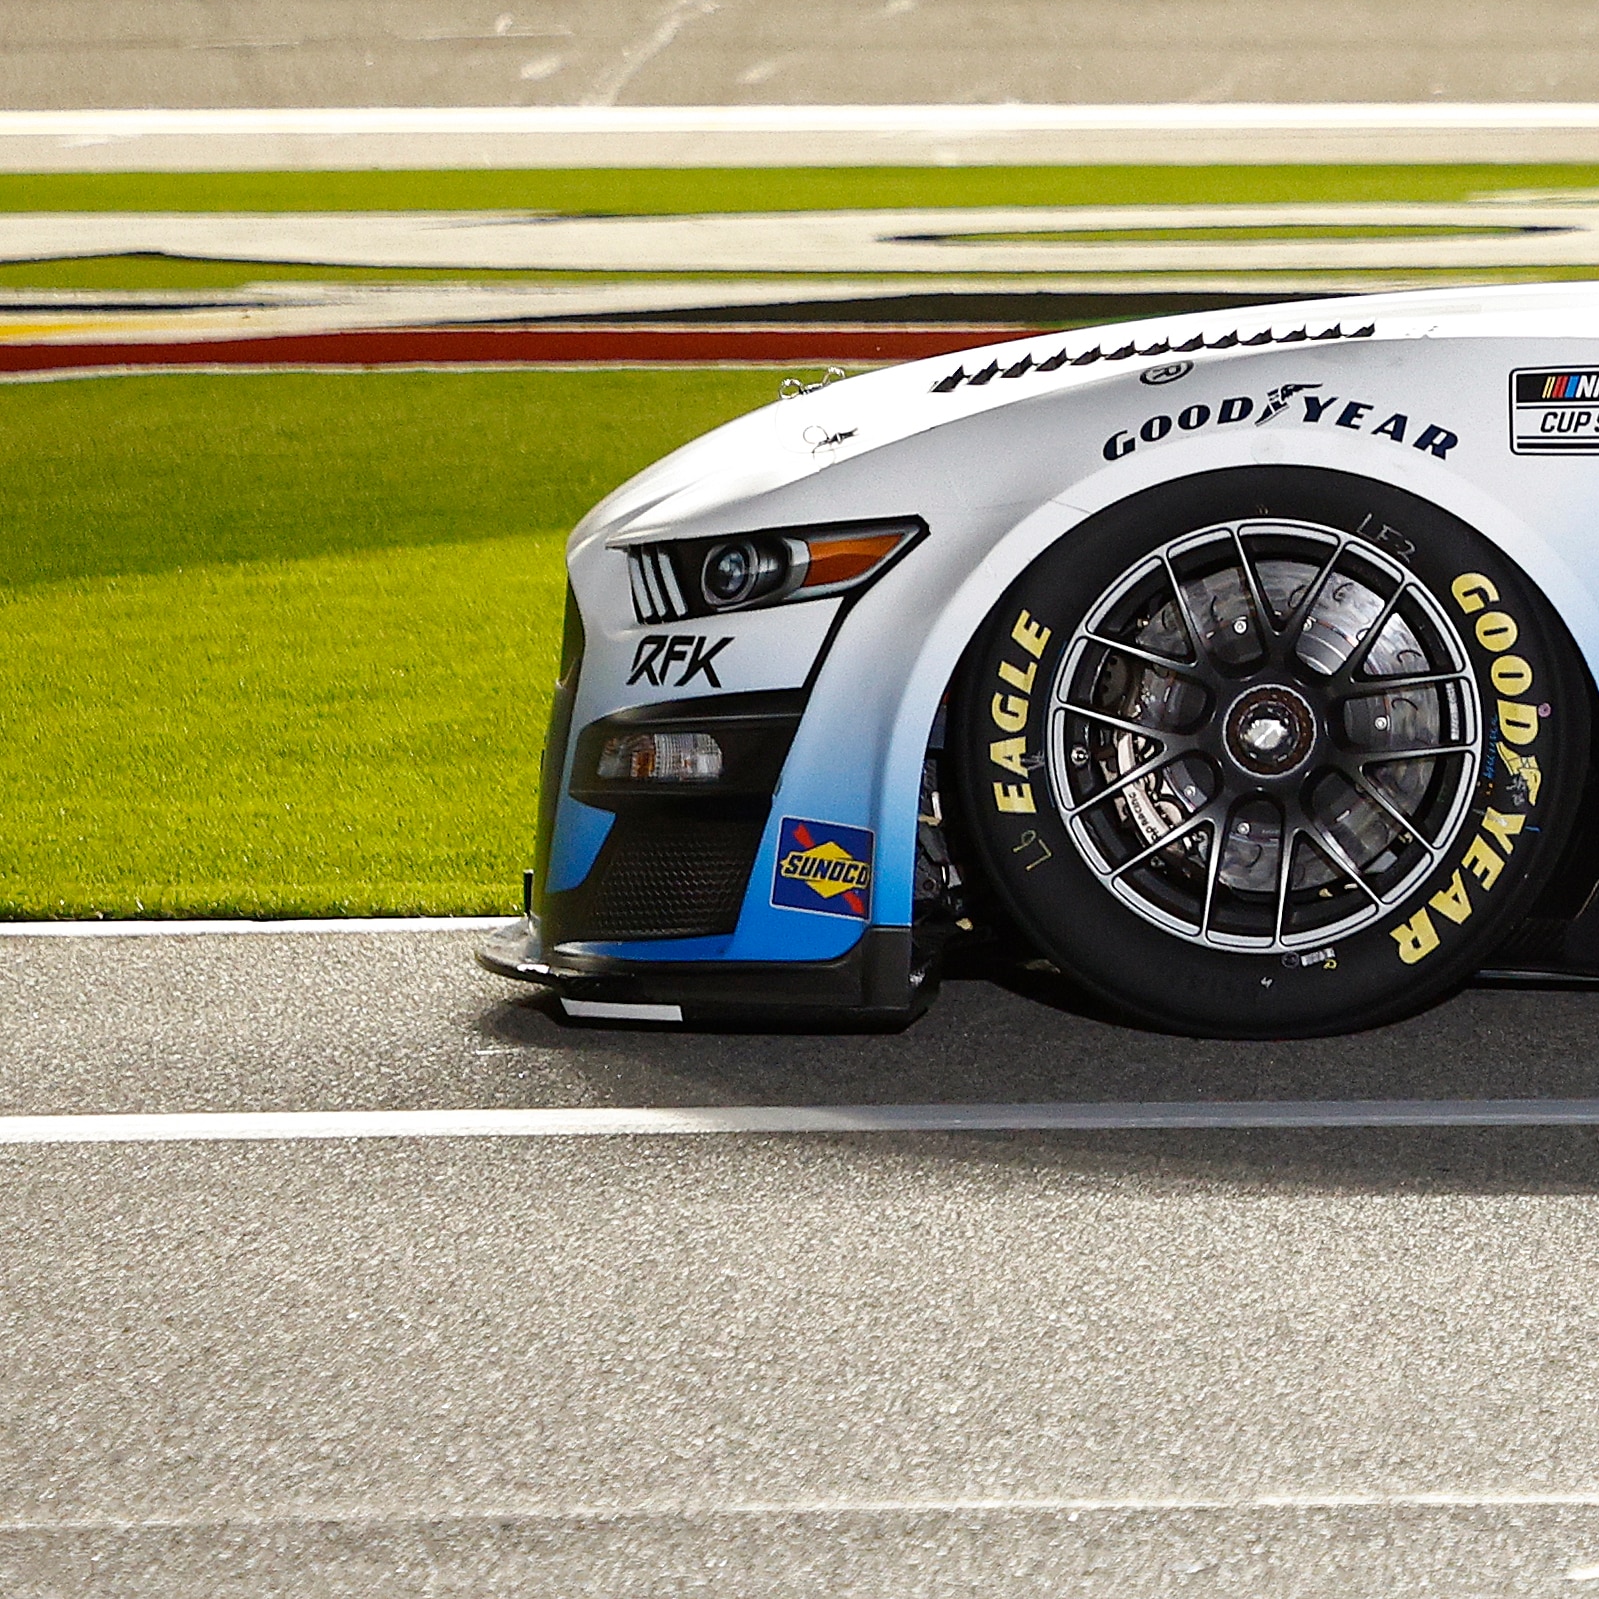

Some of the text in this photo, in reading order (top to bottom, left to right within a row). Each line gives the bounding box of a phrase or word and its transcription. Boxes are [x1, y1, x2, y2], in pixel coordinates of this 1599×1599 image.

[1540, 410, 1593, 434] CUP
[625, 633, 736, 689] RFK
[990, 609, 1052, 814] EAGLE
[784, 854, 870, 886] SUNOCO
